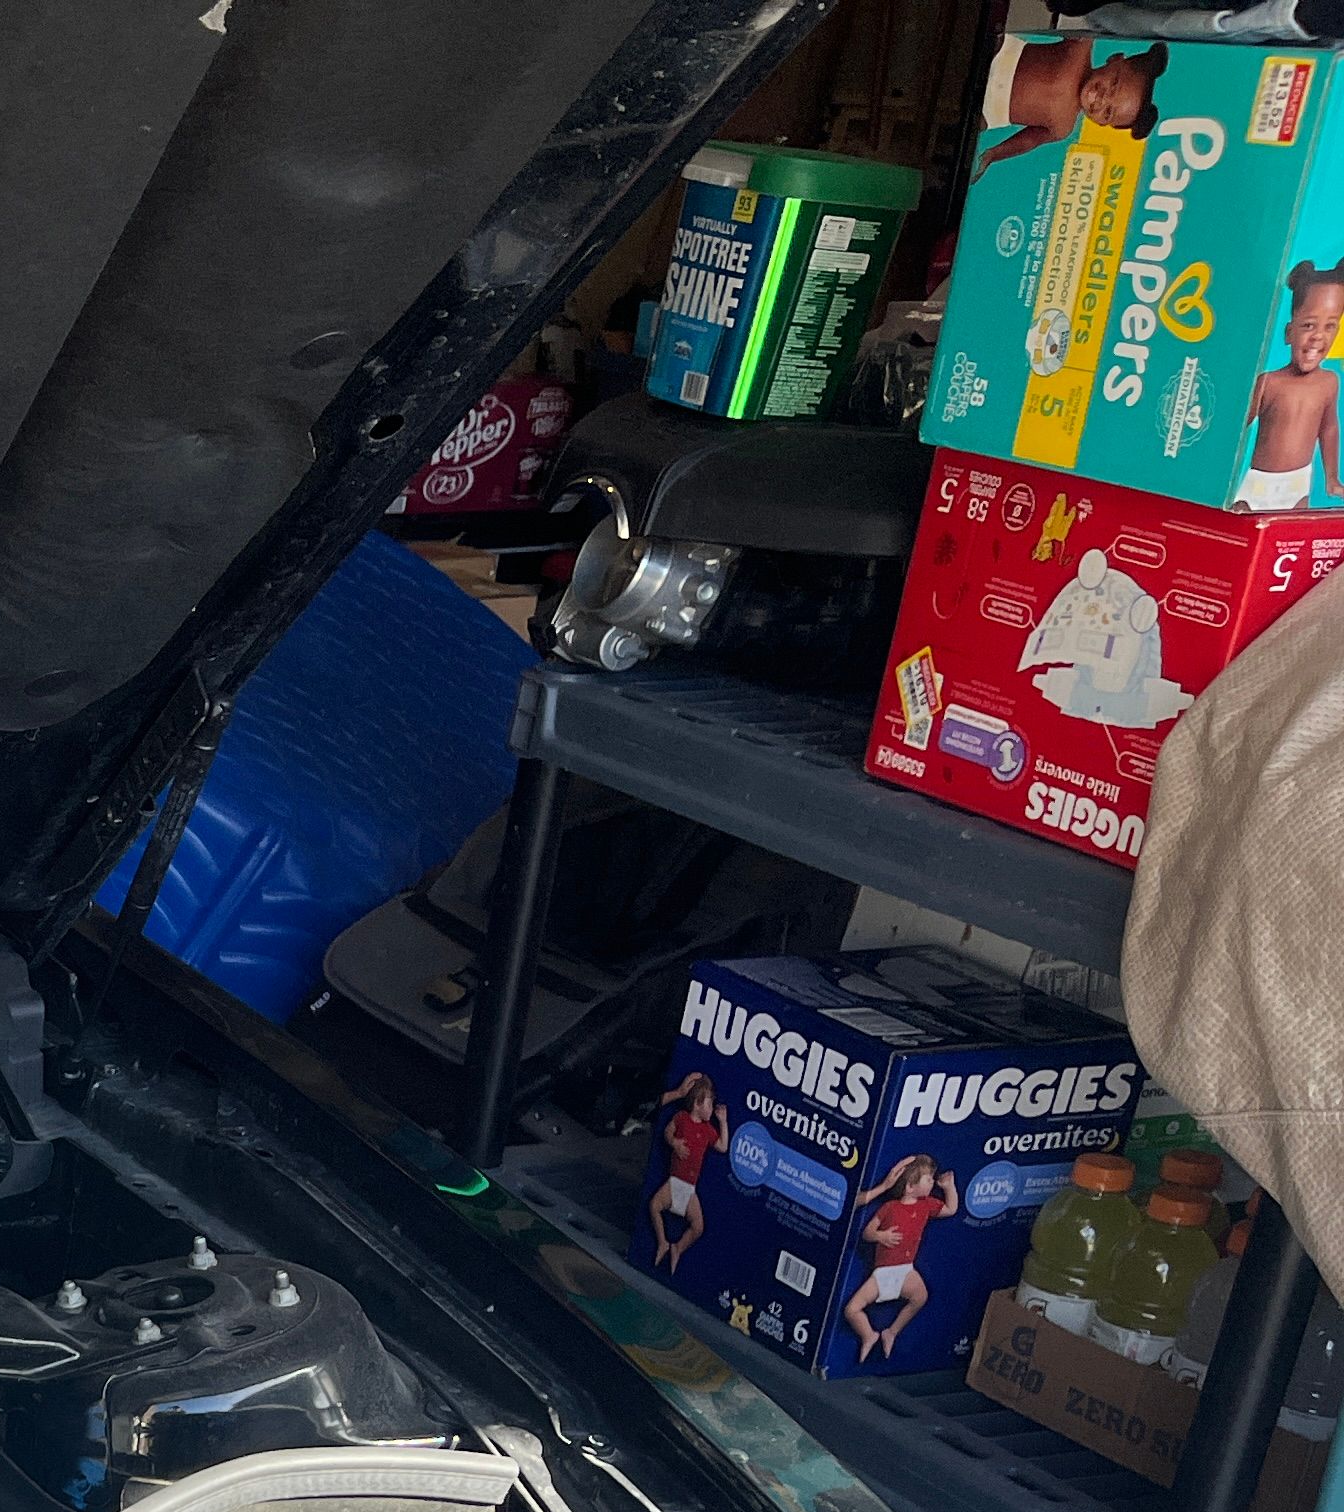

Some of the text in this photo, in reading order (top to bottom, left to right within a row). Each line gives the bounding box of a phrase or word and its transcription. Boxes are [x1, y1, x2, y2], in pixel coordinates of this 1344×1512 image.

[692, 215, 738, 236] VIRTUALLY
[1043, 157, 1083, 304] skin protection
[672, 228, 752, 274] SPOTFREE
[1059, 235, 1080, 306] LEAKPROOF
[1074, 164, 1126, 345] swaddlers
[1103, 117, 1225, 407] Pampers
[663, 262, 744, 328] SHINE
[942, 352, 967, 422] COUCHES
[955, 361, 977, 417] DIAPERS
[970, 377, 988, 406] 58
[1040, 395, 1064, 417] 5
[1167, 363, 1194, 452] PEDIATRICIAN
[436, 476, 457, 494] 23
[937, 478, 959, 513] 5
[967, 498, 989, 522] 58
[1269, 553, 1298, 592] 5
[1034, 757, 1121, 803] little movers
[1025, 781, 1145, 857] UGGIES
[680, 980, 875, 1118] HUGGIES
[894, 1063, 1137, 1128] HUGGIES
[747, 1091, 852, 1157] overnites
[984, 1124, 1112, 1155] overnites
[736, 1138, 768, 1168] 100%
[973, 1180, 1014, 1196] 100%
[768, 1301, 783, 1318] 42
[793, 1319, 811, 1344] 6
[983, 1346, 1047, 1395] ZERO
[1064, 1386, 1147, 1443] ZERO
